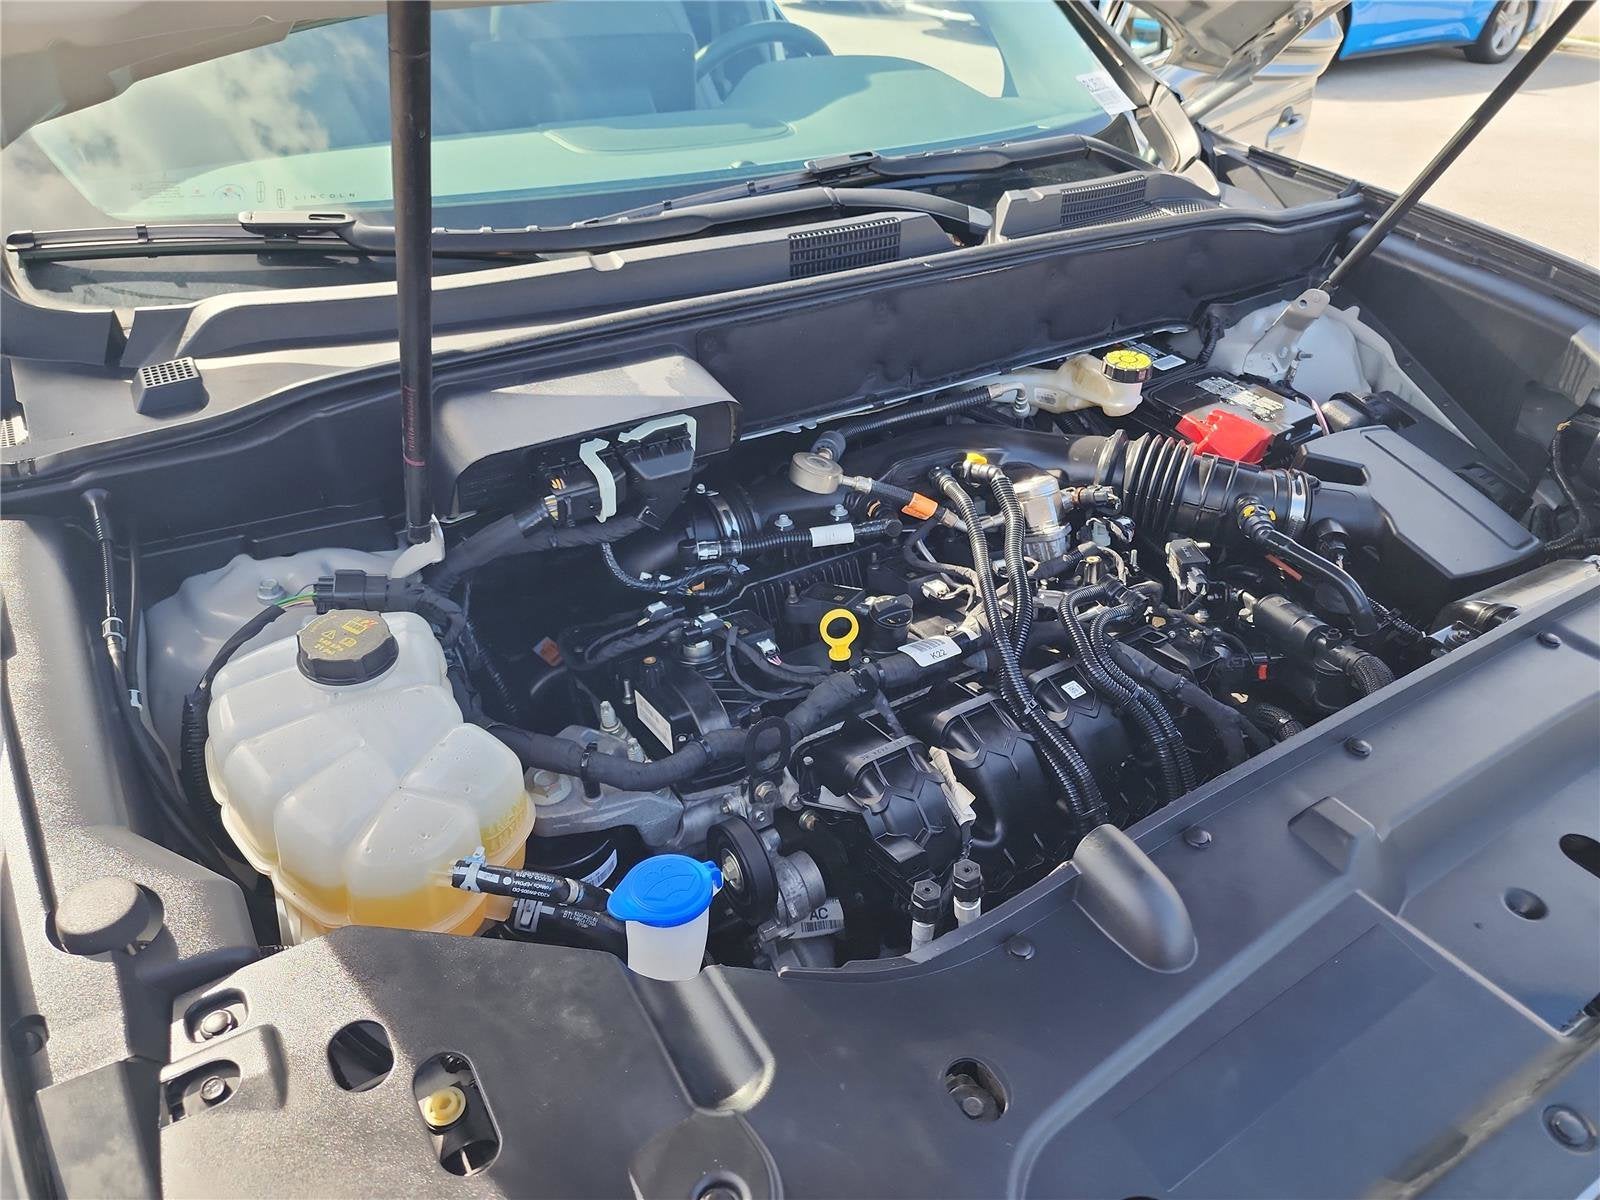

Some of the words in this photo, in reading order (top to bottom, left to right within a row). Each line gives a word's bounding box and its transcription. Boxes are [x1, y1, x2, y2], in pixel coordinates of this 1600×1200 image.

[294, 192, 356, 200] LINCOLN
[930, 649, 947, 660] K22
[810, 907, 828, 920] AC
